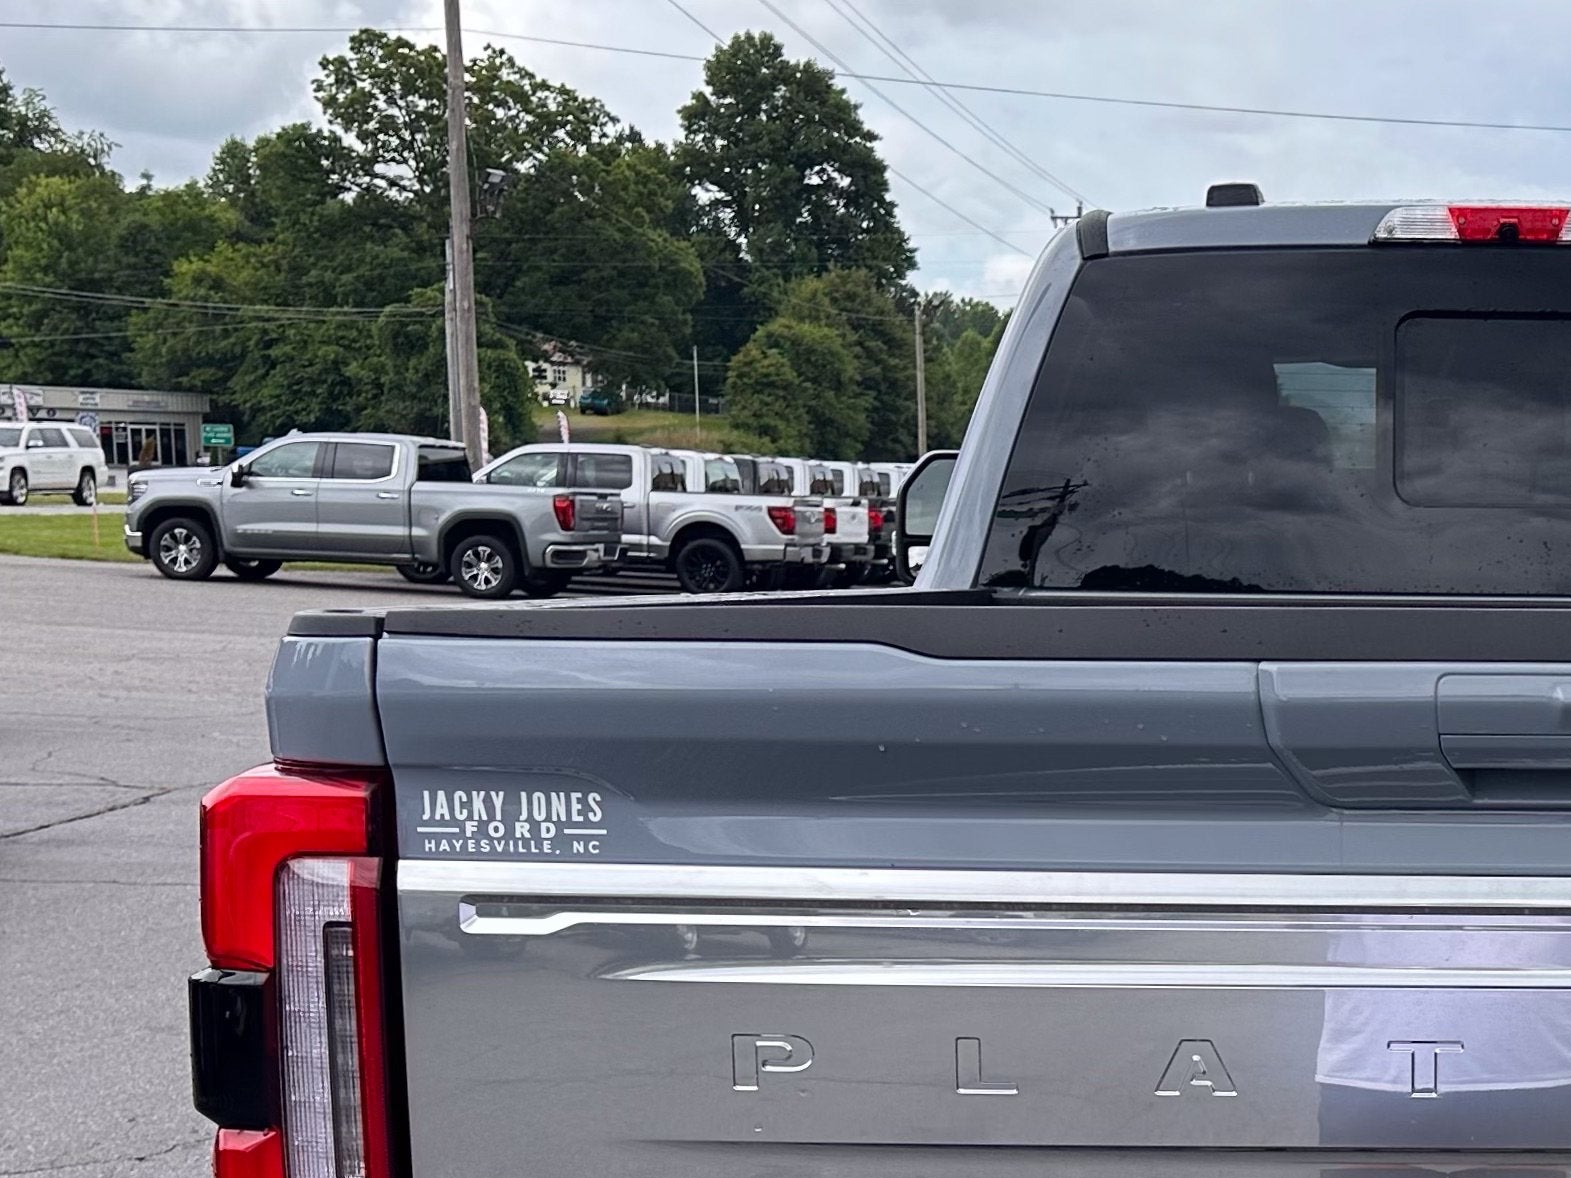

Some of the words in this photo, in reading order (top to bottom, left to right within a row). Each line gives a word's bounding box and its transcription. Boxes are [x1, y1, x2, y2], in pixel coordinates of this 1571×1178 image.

[422, 790, 504, 822] JACKY
[519, 791, 603, 823] JONES
[465, 821, 557, 839] FORD
[424, 839, 561, 855] HAYESVILLE,
[572, 841, 601, 854] NC
